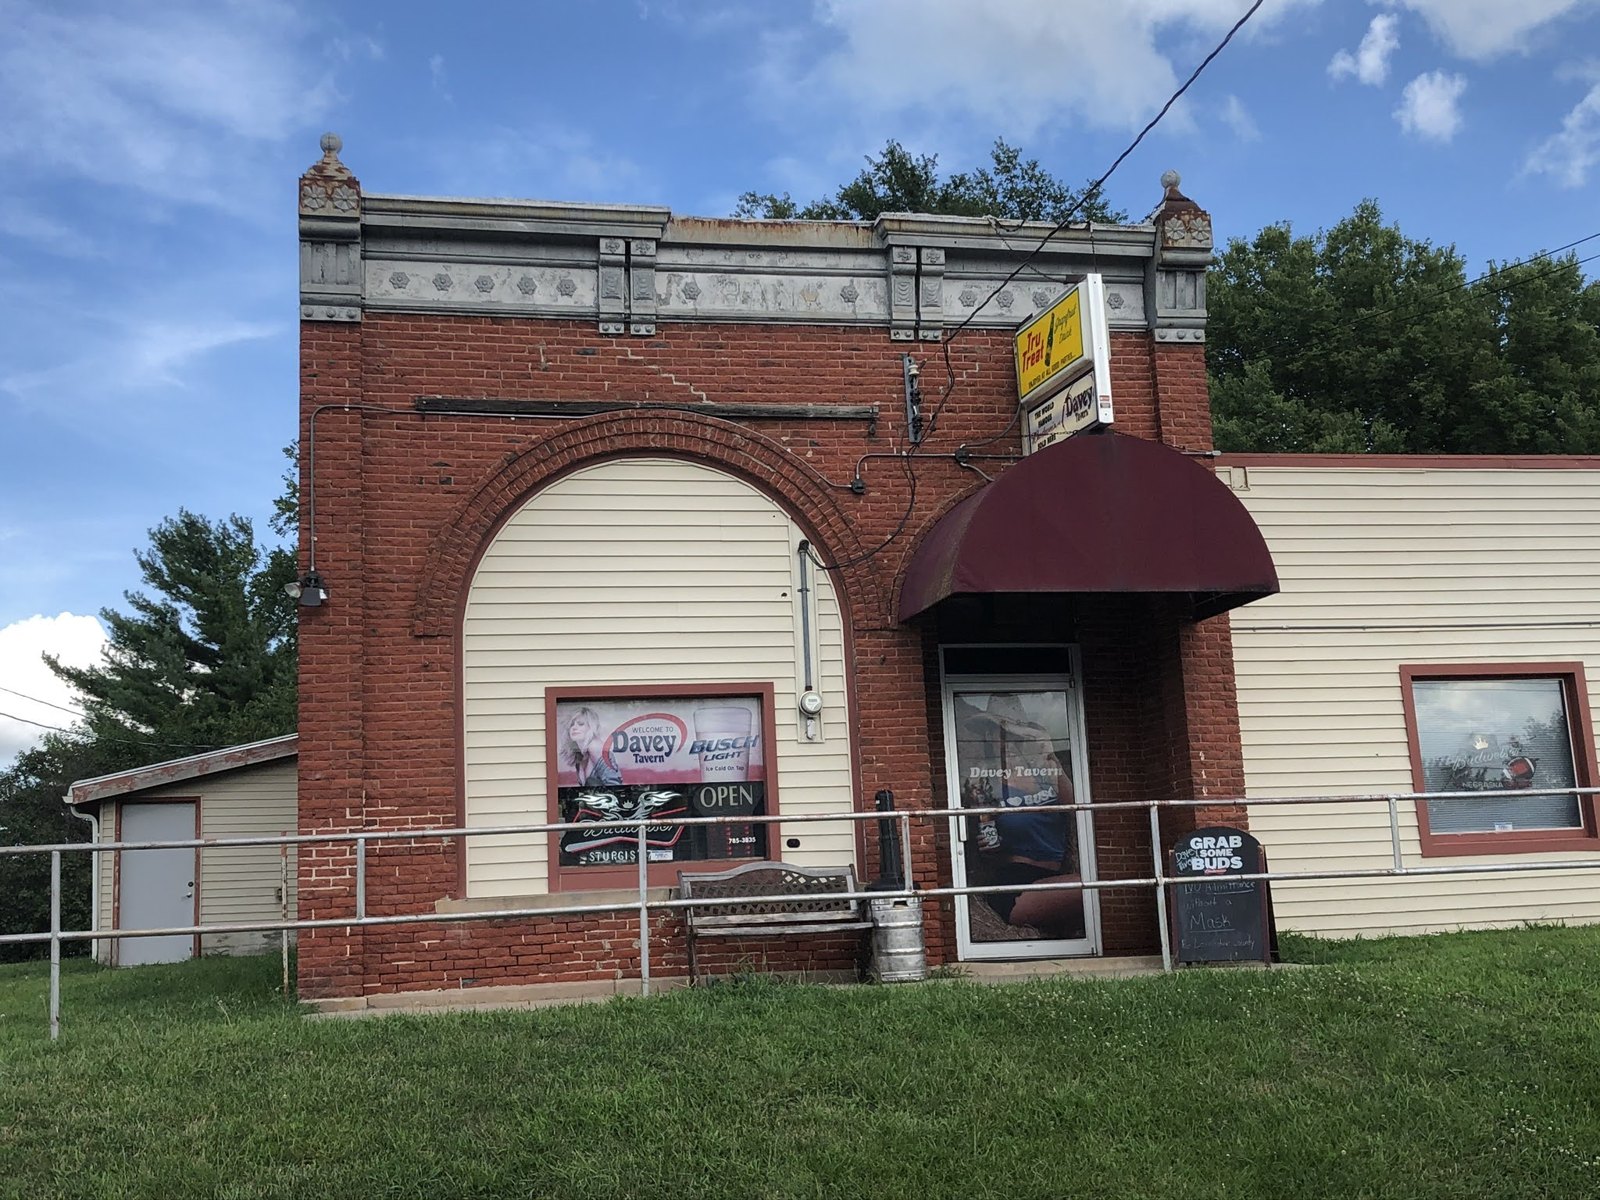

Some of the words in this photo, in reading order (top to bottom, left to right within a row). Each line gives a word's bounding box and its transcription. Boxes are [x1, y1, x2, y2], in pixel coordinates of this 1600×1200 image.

[1027, 331, 1041, 353] Tru
[1022, 340, 1044, 373] Treat
[1064, 386, 1093, 418] Davey
[611, 730, 677, 757] Davey
[688, 734, 760, 755] BUSCH
[633, 753, 665, 763] Tavern
[703, 751, 745, 762] LIGHT
[970, 767, 1011, 779] Davey
[1015, 766, 1062, 777] Tavern
[700, 785, 754, 808] OPEN
[1190, 835, 1242, 850] GRAB
[589, 849, 636, 862] STURGIS
[1200, 848, 1233, 858] SOME
[1191, 856, 1243, 871] BUDS
[1190, 911, 1232, 930] Mask
